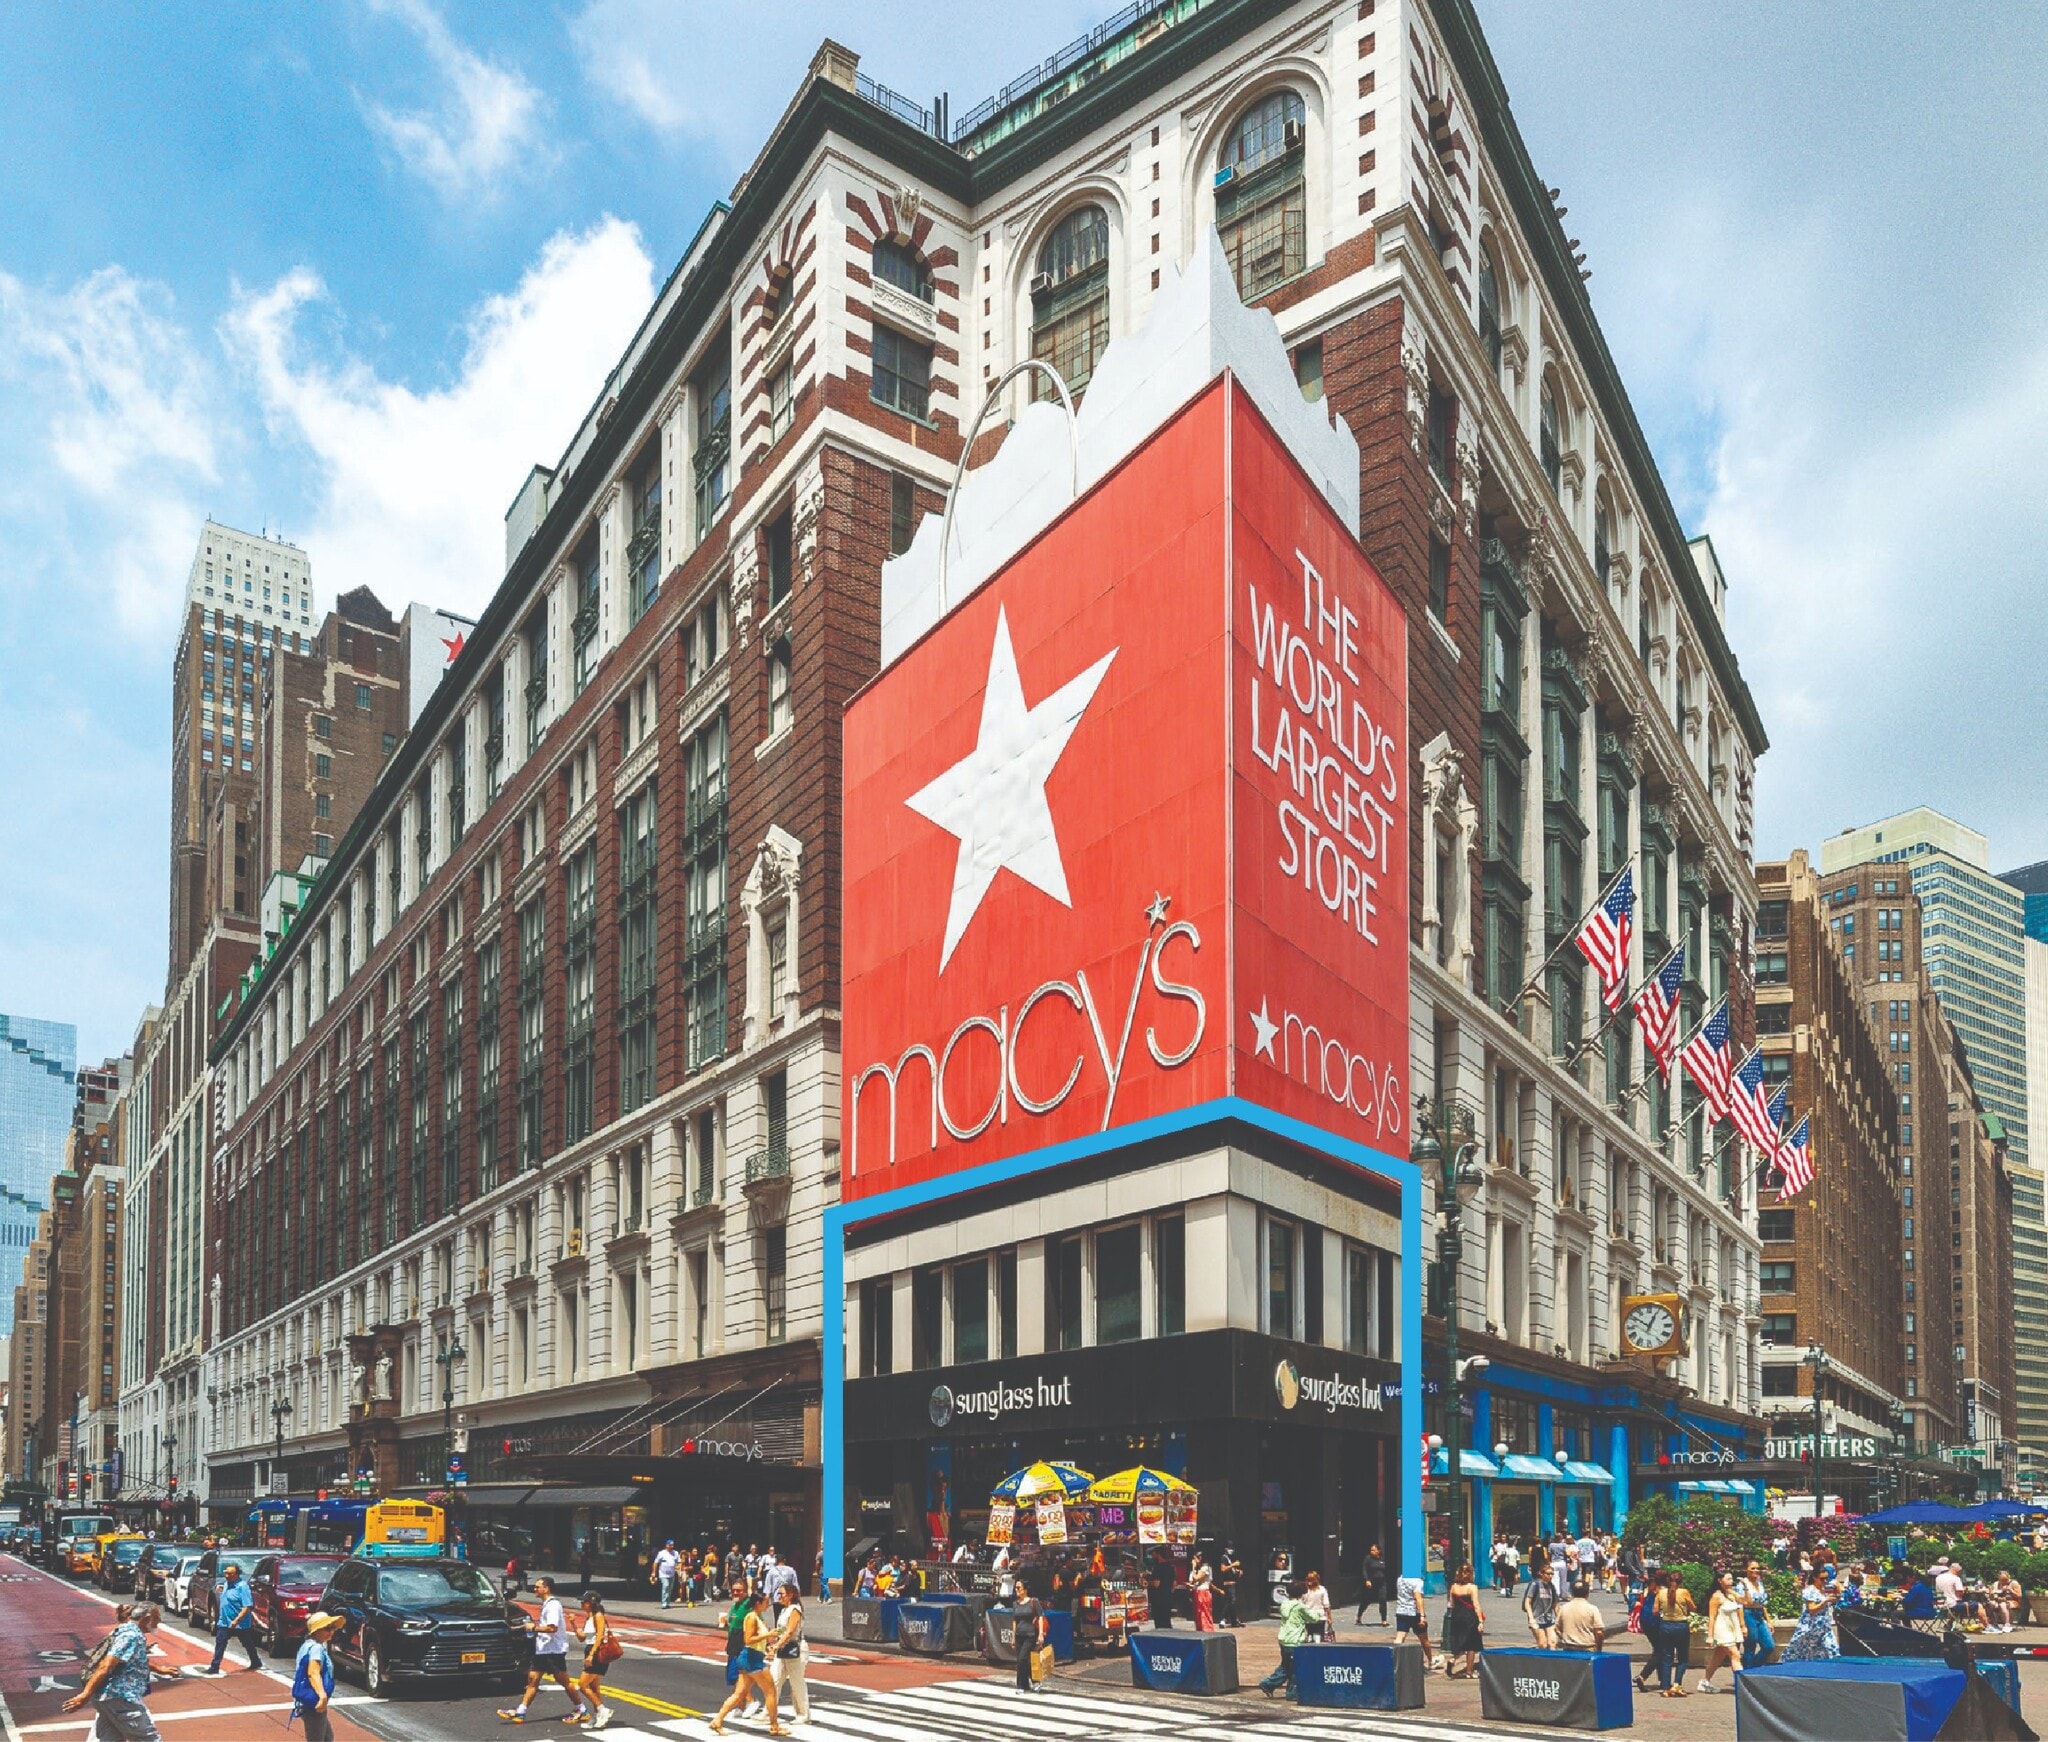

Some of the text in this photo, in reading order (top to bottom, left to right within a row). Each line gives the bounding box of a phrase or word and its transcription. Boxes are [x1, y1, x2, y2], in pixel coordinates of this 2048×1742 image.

[1295, 546, 1359, 686] THE
[1249, 580, 1397, 802] WORLD'S
[1251, 676, 1394, 874] LARGEST
[1278, 799, 1378, 947] STORE
[851, 891, 1206, 1178] macy's
[1284, 1009, 1401, 1140] macy's
[956, 1375, 1072, 1421] sunglass hut
[1300, 1372, 1383, 1414] sunglass hut
[1384, 1384, 1403, 1399] Wes
[1428, 1381, 1438, 1393] St
